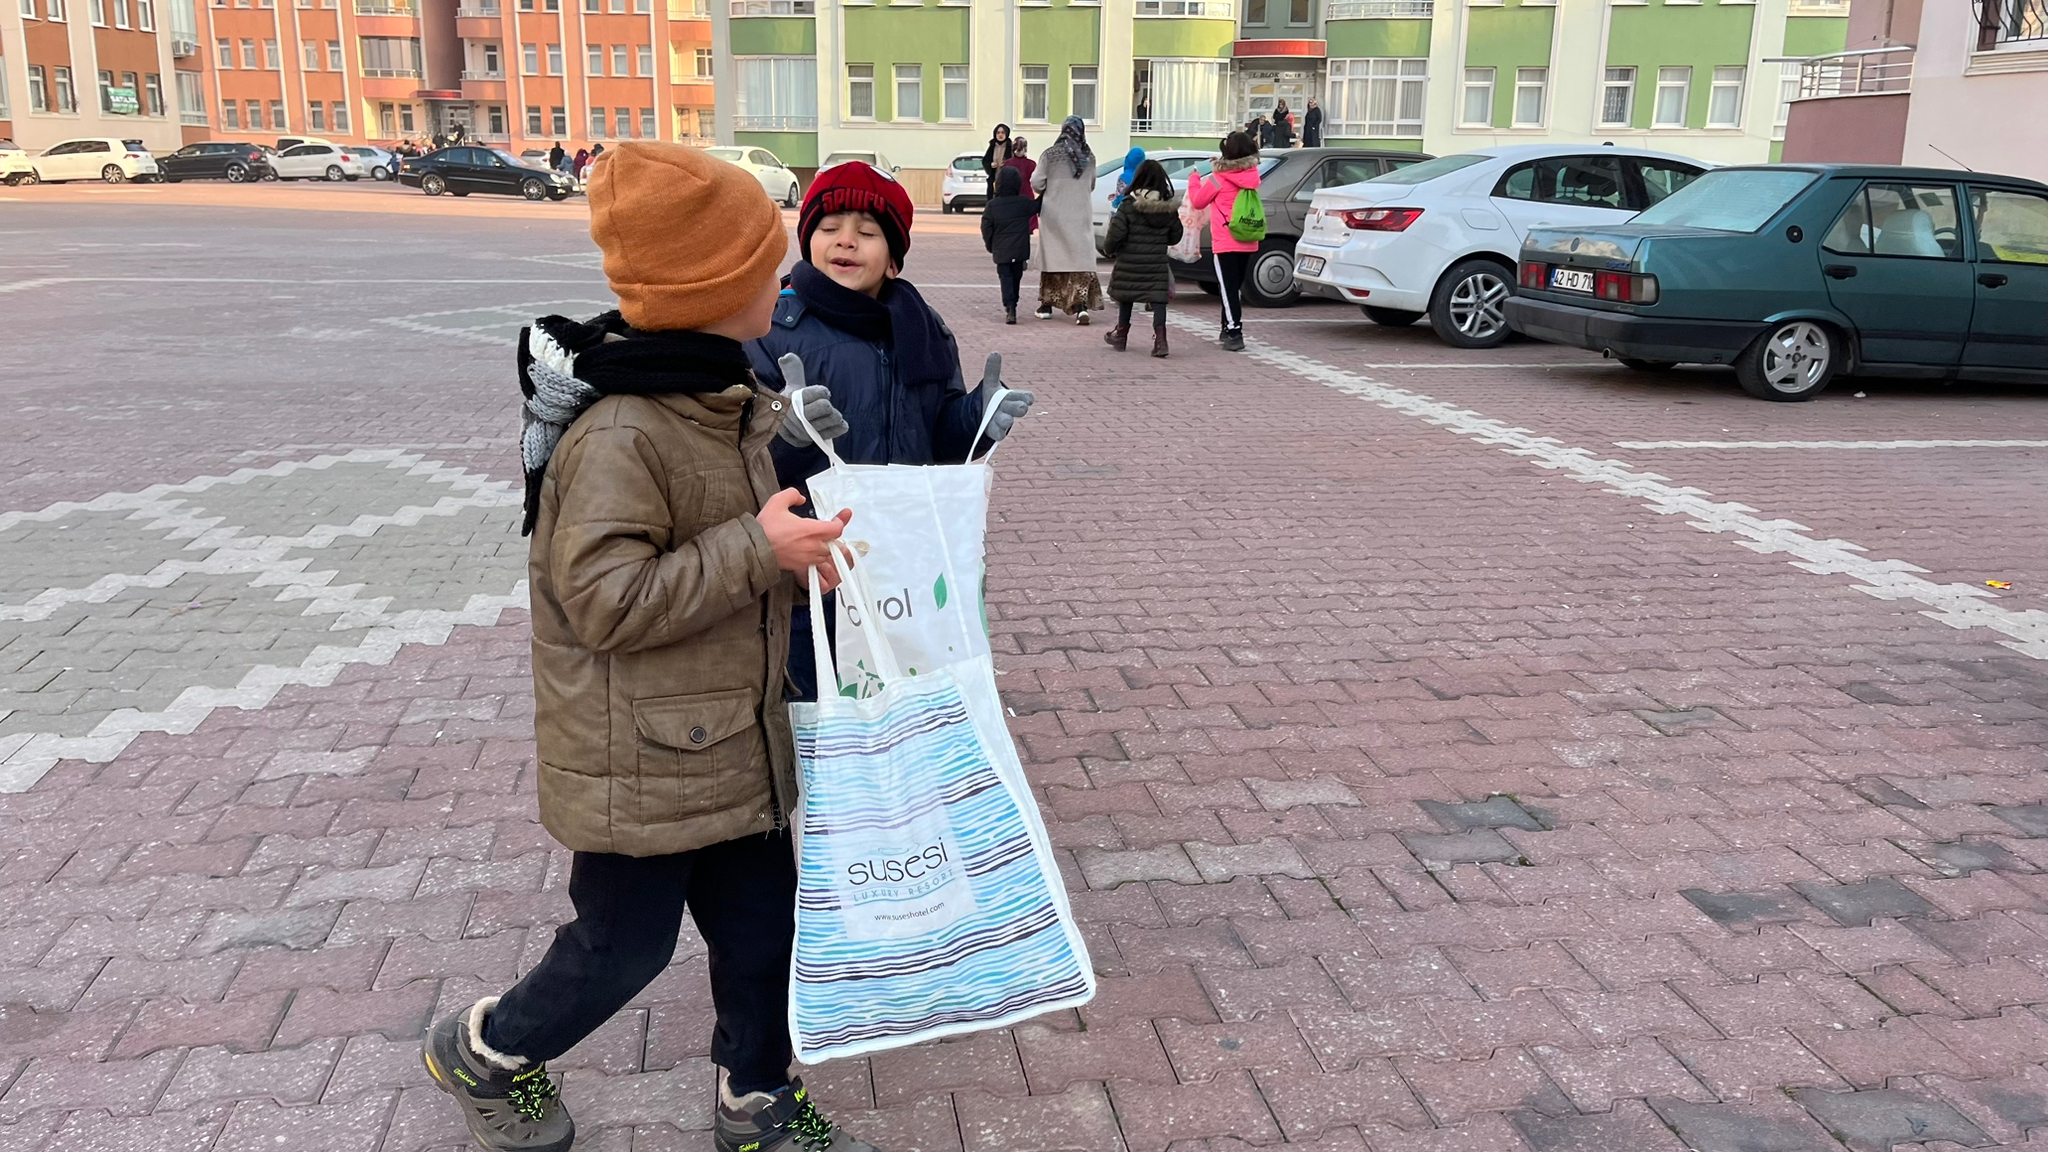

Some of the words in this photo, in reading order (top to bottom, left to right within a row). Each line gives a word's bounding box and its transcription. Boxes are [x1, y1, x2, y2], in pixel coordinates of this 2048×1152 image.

[1553, 270, 1565, 286] 42
[1566, 272, 1580, 288] HD
[847, 836, 949, 886] susesi
[853, 889, 900, 902] LUXURY
[908, 868, 955, 896] RESORT
